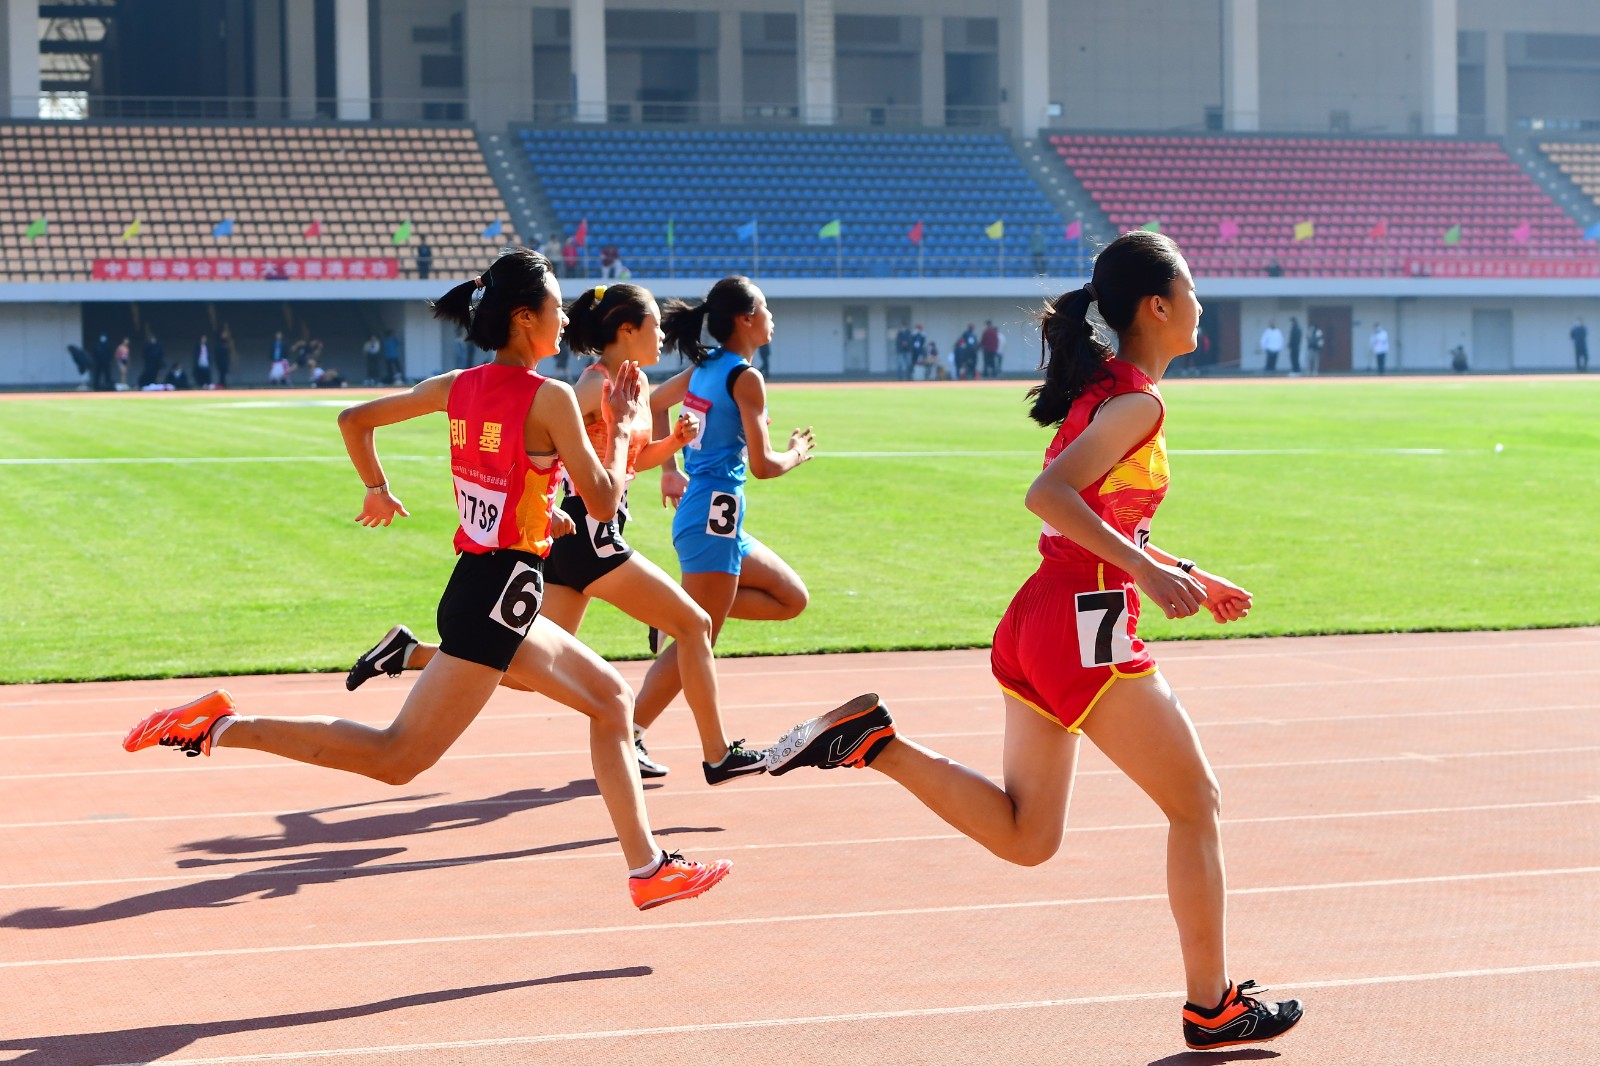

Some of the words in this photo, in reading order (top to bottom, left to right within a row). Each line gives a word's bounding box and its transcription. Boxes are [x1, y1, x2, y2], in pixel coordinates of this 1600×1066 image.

[450, 419, 502, 453] 即墨
[460, 489, 498, 532] 7738
[709, 494, 737, 535] 3
[594, 521, 624, 551] 4
[501, 570, 542, 628] 6
[1077, 591, 1125, 664] 7
